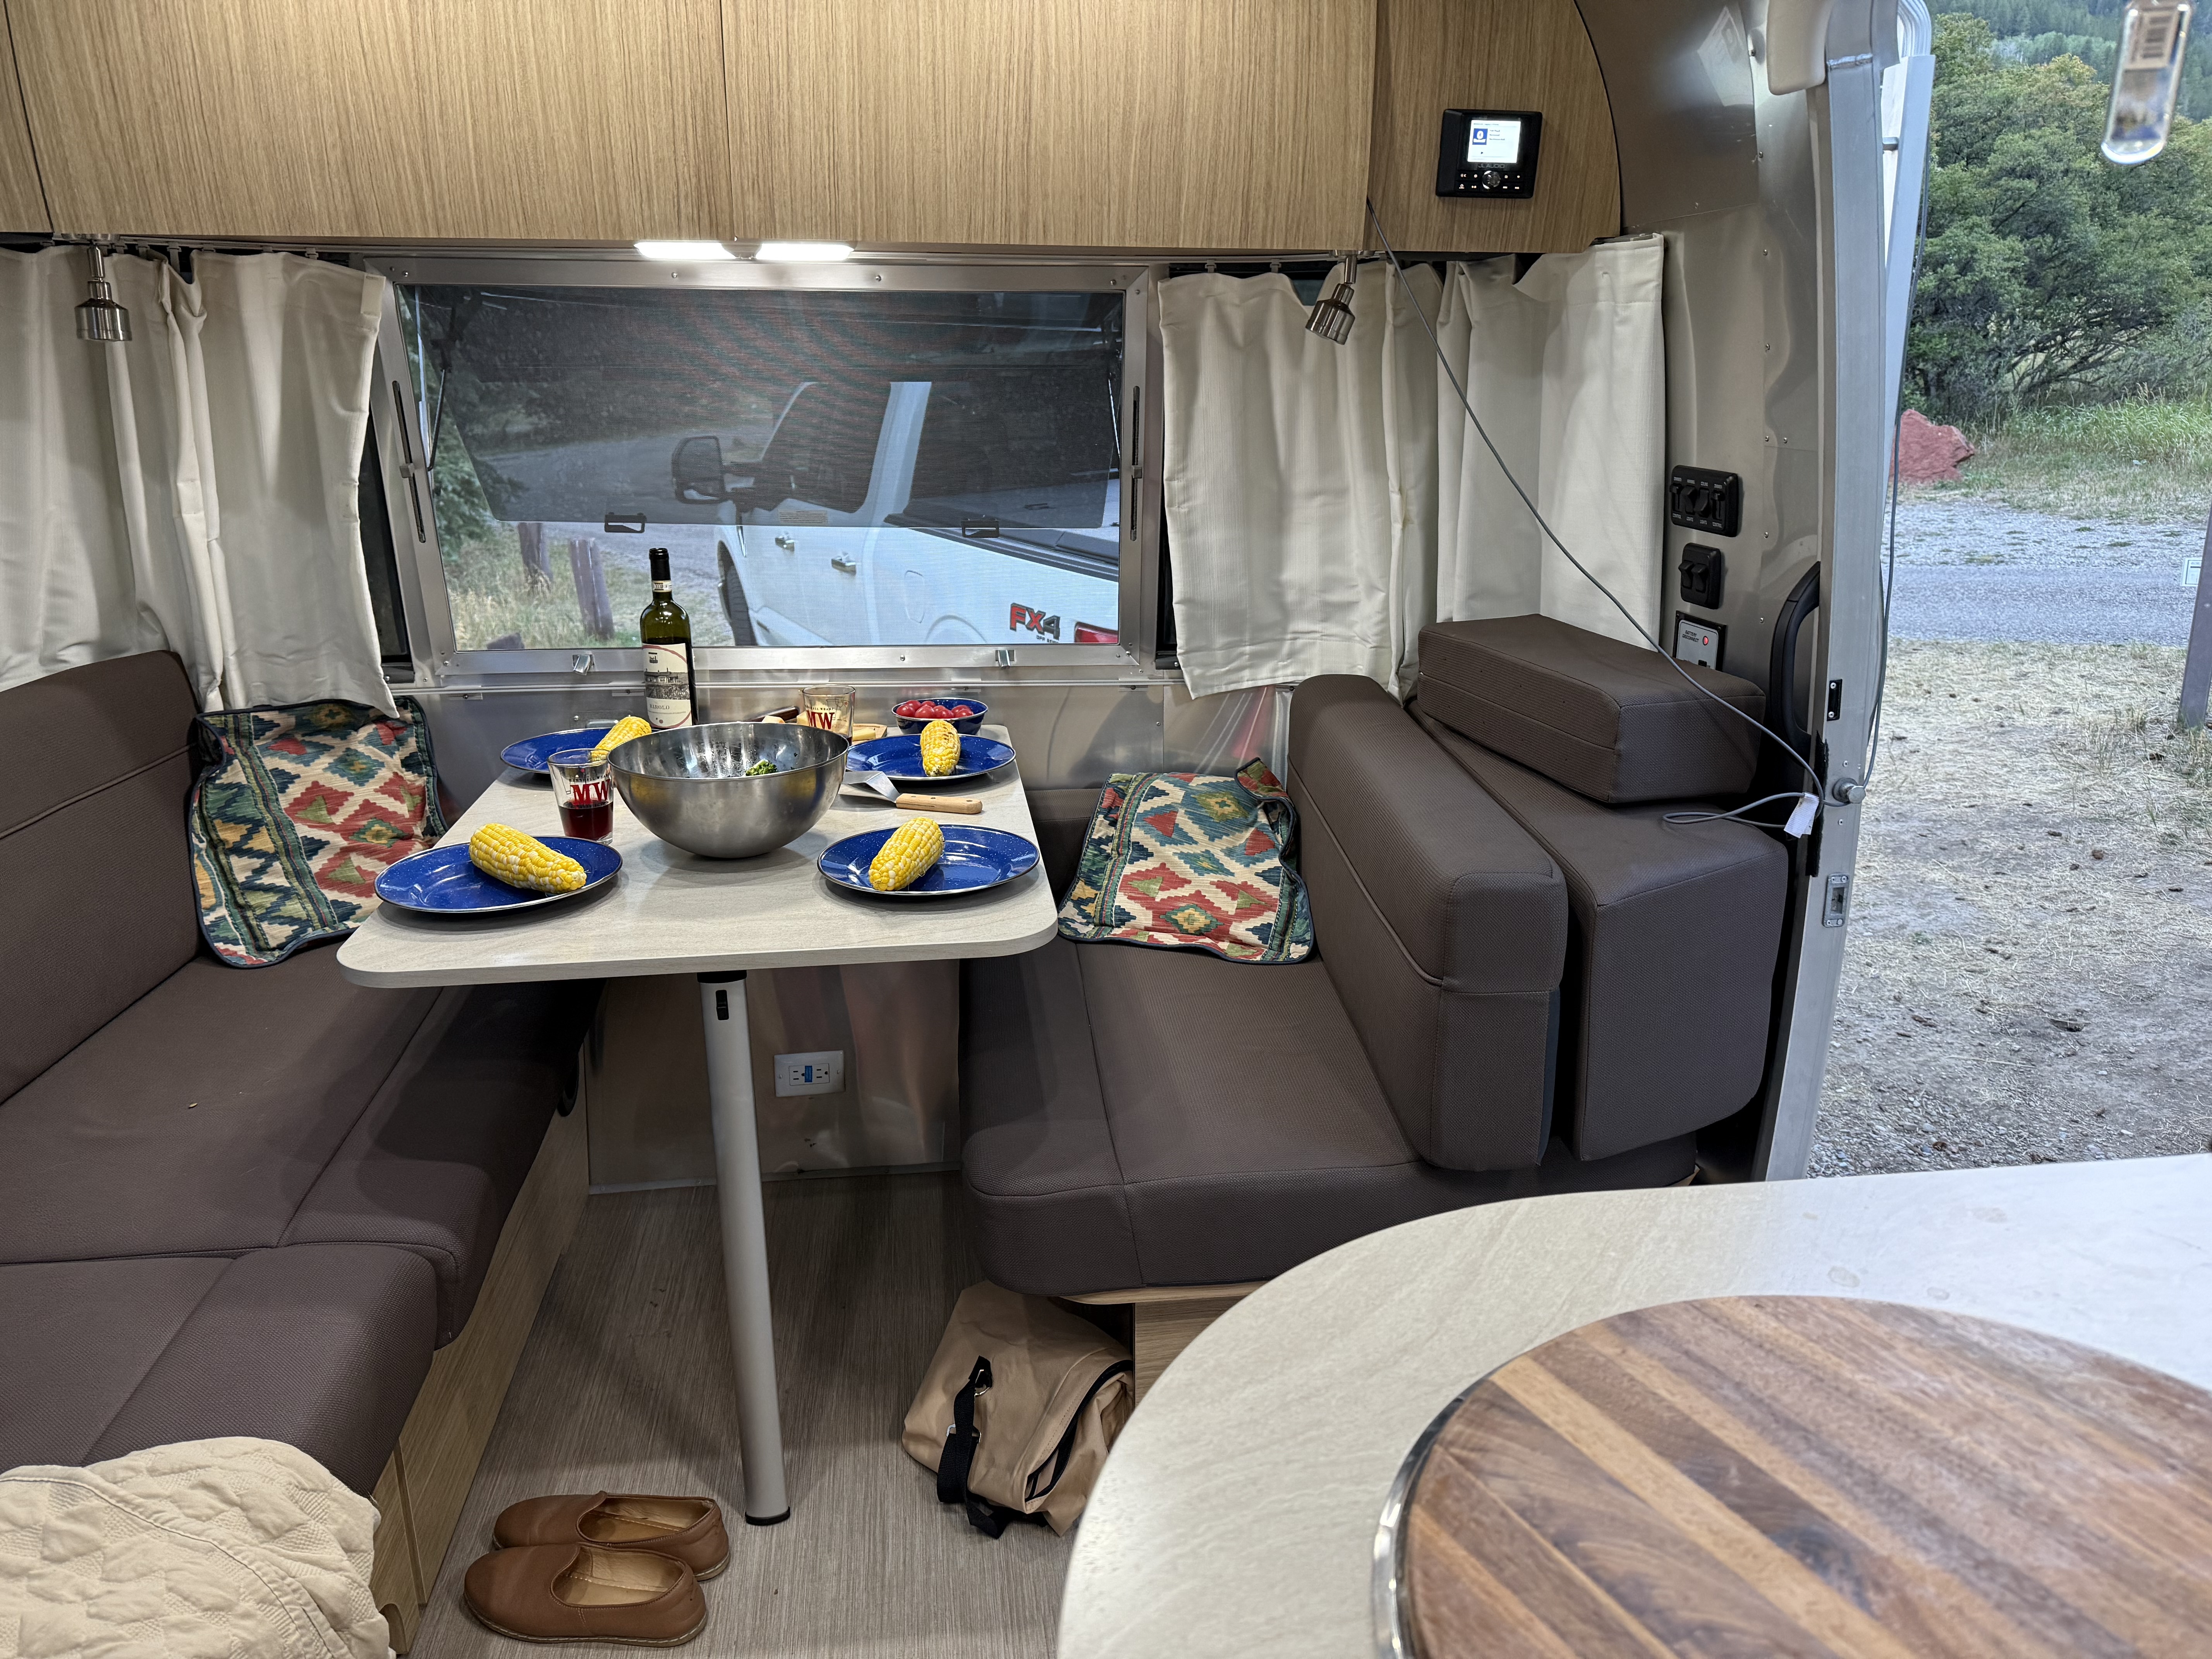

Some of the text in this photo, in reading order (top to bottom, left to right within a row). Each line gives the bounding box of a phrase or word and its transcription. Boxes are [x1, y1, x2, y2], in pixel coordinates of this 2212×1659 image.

[1010, 603, 1060, 641] FX4
[806, 709, 835, 730] MW
[570, 778, 610, 805] MW
